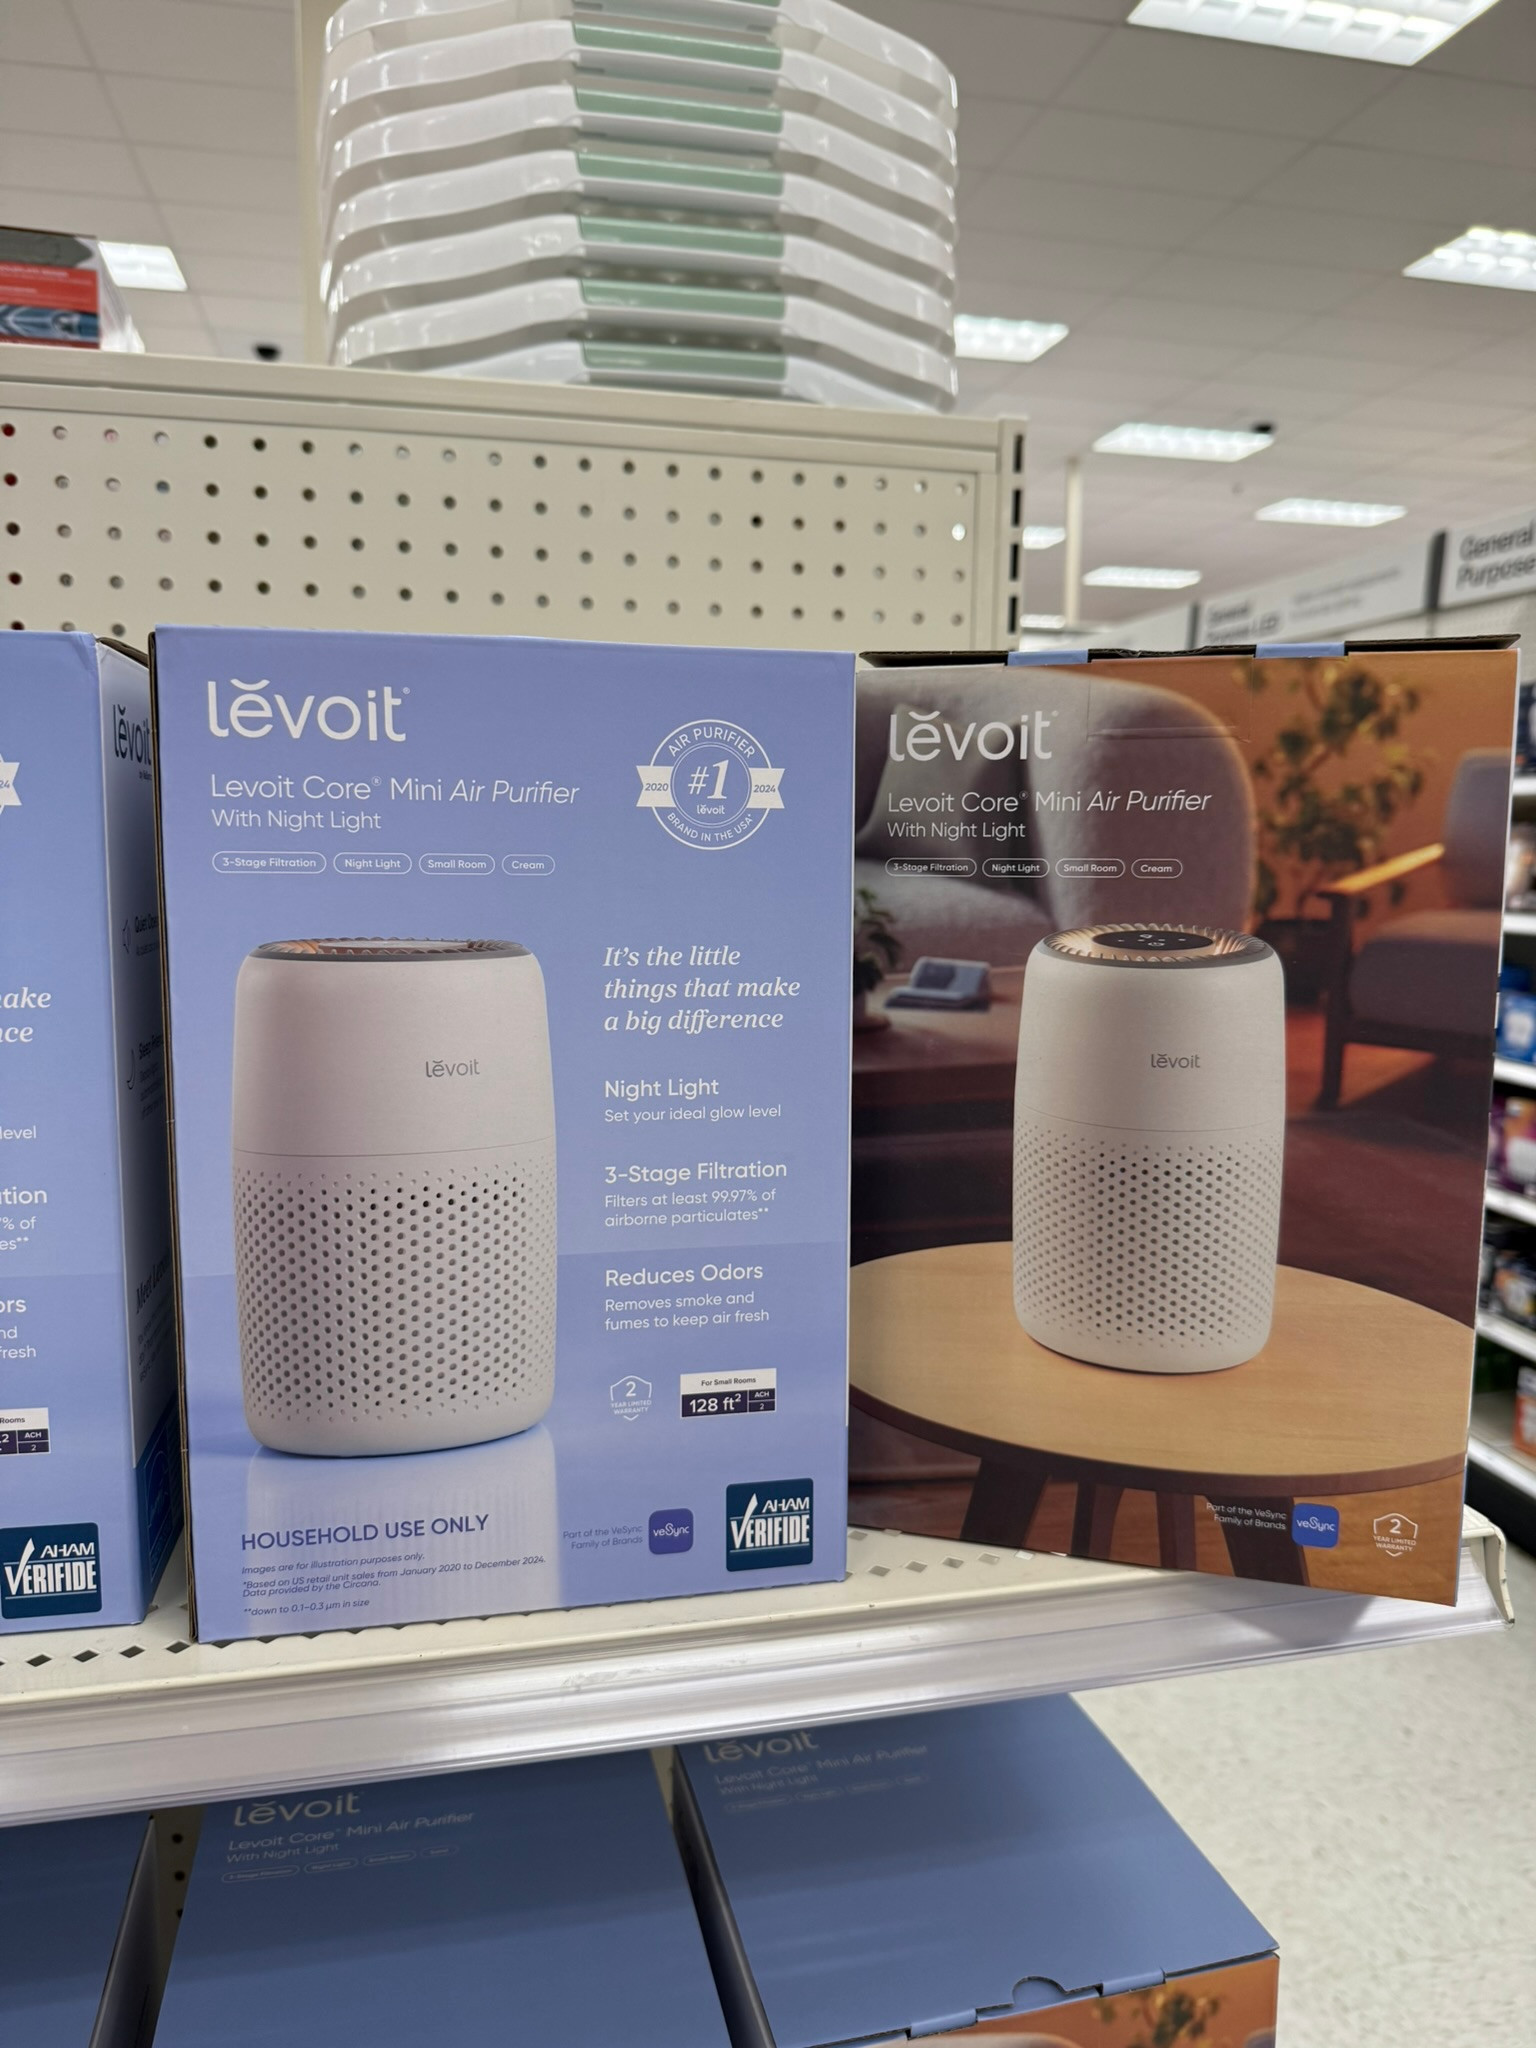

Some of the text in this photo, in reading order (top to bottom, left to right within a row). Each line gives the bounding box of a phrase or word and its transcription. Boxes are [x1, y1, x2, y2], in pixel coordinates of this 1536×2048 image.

[1459, 520, 1534, 561] General
[668, 726, 755, 758] AIR PURIFIER
[645, 782, 669, 791] 2020
[688, 759, 729, 799] #1
[211, 774, 294, 799] Levoit
[390, 777, 442, 801] Mini
[449, 779, 485, 802] Air
[492, 779, 580, 804] Purifier
[753, 784, 776, 793] 2024
[888, 792, 954, 813] Levoit
[1035, 791, 1081, 812] Mini
[1087, 790, 1121, 812] Air
[1126, 789, 1213, 812] Purifier
[211, 808, 382, 833] With Night Light
[667, 812, 698, 839] BRAND
[701, 832, 711, 841] IN
[714, 829, 733, 842] THE
[887, 822, 1026, 842] With Night Light
[222, 857, 317, 868] 3-Stage Filtration
[344, 858, 401, 870] Night Light
[428, 859, 486, 869] Small Room
[511, 860, 544, 869] Cream
[893, 862, 969, 873] 3-Stage Filtration
[992, 863, 1040, 873] Night Light
[1063, 863, 1117, 873] Small Room
[1140, 864, 1173, 873] Cream
[646, 946, 683, 966] the
[689, 945, 741, 966] little
[0, 986, 52, 1009] ake
[604, 976, 801, 1003] things that make
[604, 1008, 784, 1036] a big difference
[604, 1078, 720, 1102] Night Light
[604, 1104, 782, 1125] Set your ideal glow level
[0, 1125, 37, 1139] level
[604, 1160, 788, 1186] 3-Stage Filtration
[605, 1188, 776, 1208] Filters at least 99.97% of
[20, 1216, 36, 1229] of
[605, 1213, 668, 1228] airborne
[605, 1263, 764, 1287] Reduces Odors
[605, 1291, 755, 1312] Removes smoke and
[605, 1309, 770, 1331] fumes to keep air fresh
[625, 1380, 637, 1398] 2
[700, 1377, 757, 1387] For Small Rooms
[628, 1399, 652, 1407] LIMITED
[754, 1390, 770, 1398] ACH
[613, 1406, 649, 1415] WARRANTY
[689, 1398, 719, 1414] 128
[24, 1431, 42, 1439] ACH
[761, 1496, 810, 1513] AHAM
[1206, 1502, 1287, 1520] Part the VeSync
[730, 1495, 810, 1549] VERIFIDE
[1214, 1513, 1287, 1530] Family Brands
[1389, 1518, 1401, 1534] 2
[241, 1514, 489, 1550] HOUSEHOLD USE ONLY
[563, 1525, 643, 1539] Part the VeSync
[1373, 1535, 1417, 1546] YEAR LIMITED
[40, 1542, 95, 1558] AHAM
[571, 1536, 643, 1550] Family Brands
[1376, 1542, 1414, 1552] WARRANTY
[4, 1538, 97, 1596] VERIFIDE
[241, 1552, 425, 1575] Images for illustration purposes only.
[292, 1576, 305, 1585] US
[306, 1574, 331, 1584] retail
[332, 1573, 350, 1582] unit
[351, 1570, 375, 1580] sales
[377, 1569, 398, 1578] from
[400, 1566, 437, 1577] January
[438, 1563, 462, 1573] 2020
[475, 1557, 521, 1570] December
[522, 1555, 546, 1566] 2024.
[242, 1579, 381, 1597] Data provided by the Circana.
[352, 1598, 370, 1607] size
[228, 1835, 283, 1851] Levoit
[346, 1824, 382, 1838] Mini
[386, 1819, 409, 1832] Air
[227, 1842, 340, 1864] With Night Light
